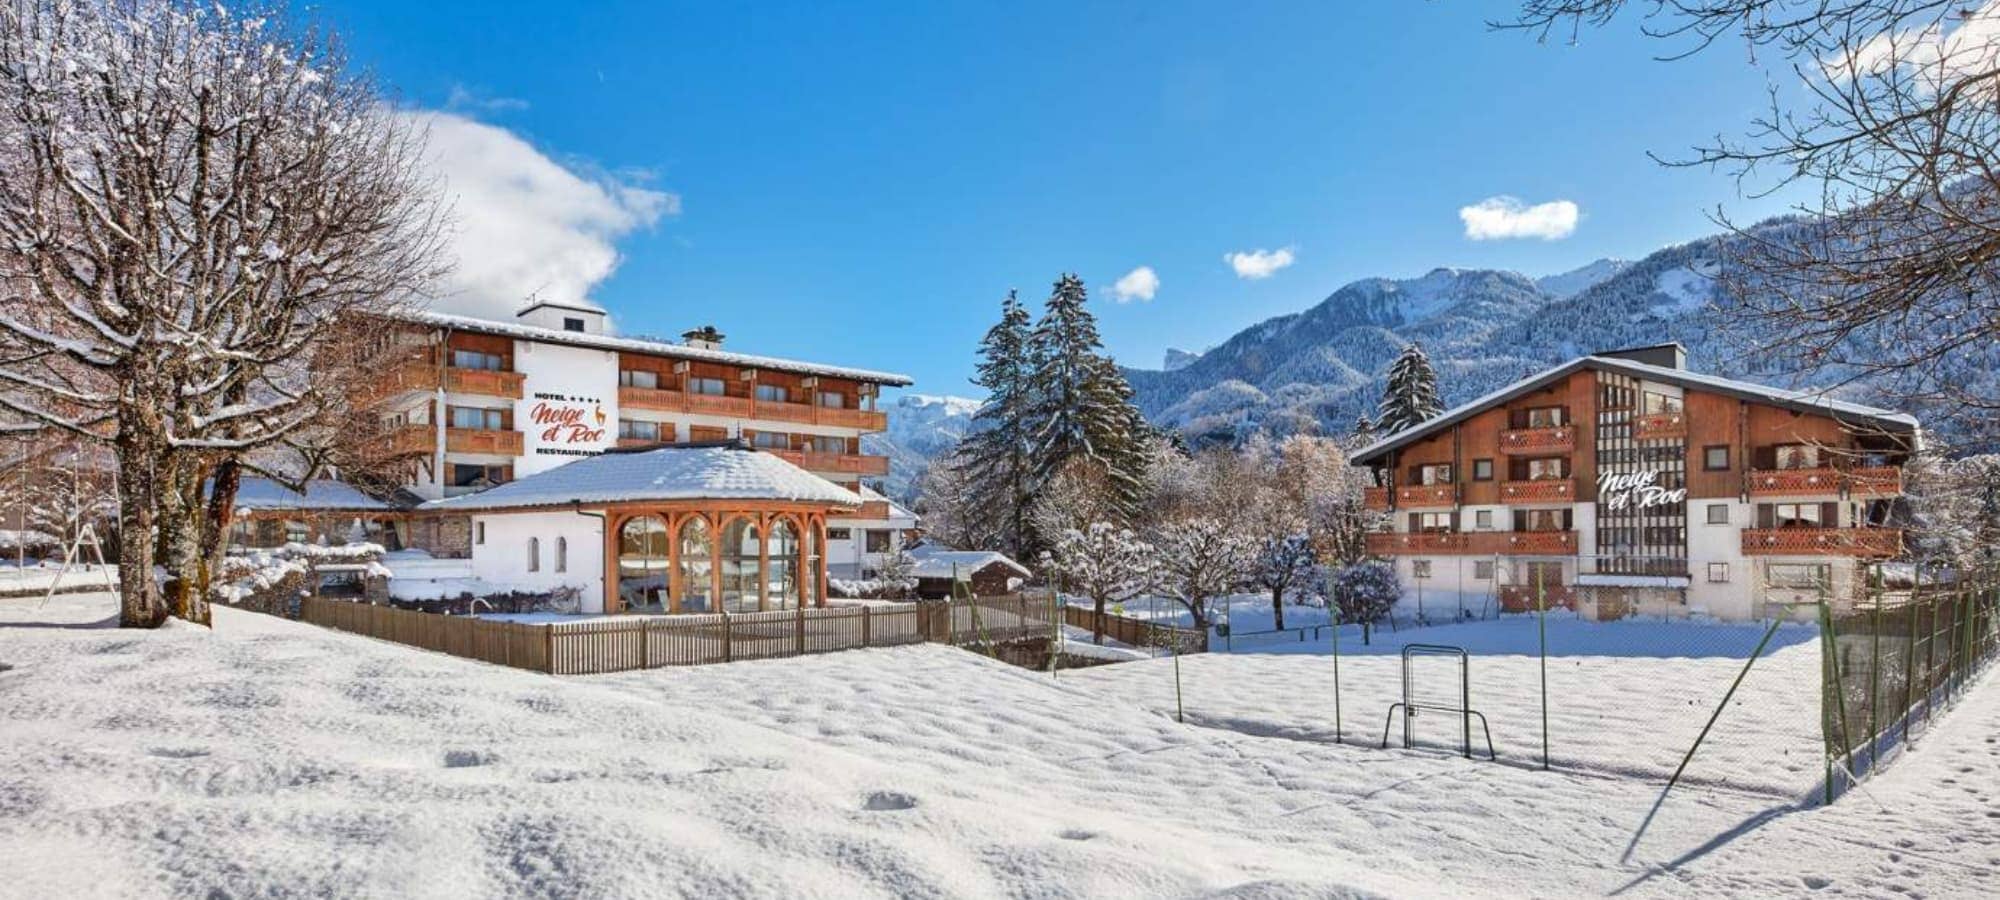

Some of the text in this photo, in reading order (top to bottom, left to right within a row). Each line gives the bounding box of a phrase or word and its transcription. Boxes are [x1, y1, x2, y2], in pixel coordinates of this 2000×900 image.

[534, 391, 566, 401] HOTEL
[541, 423, 605, 443] et Roc
[1608, 486, 1688, 510] et Roc
